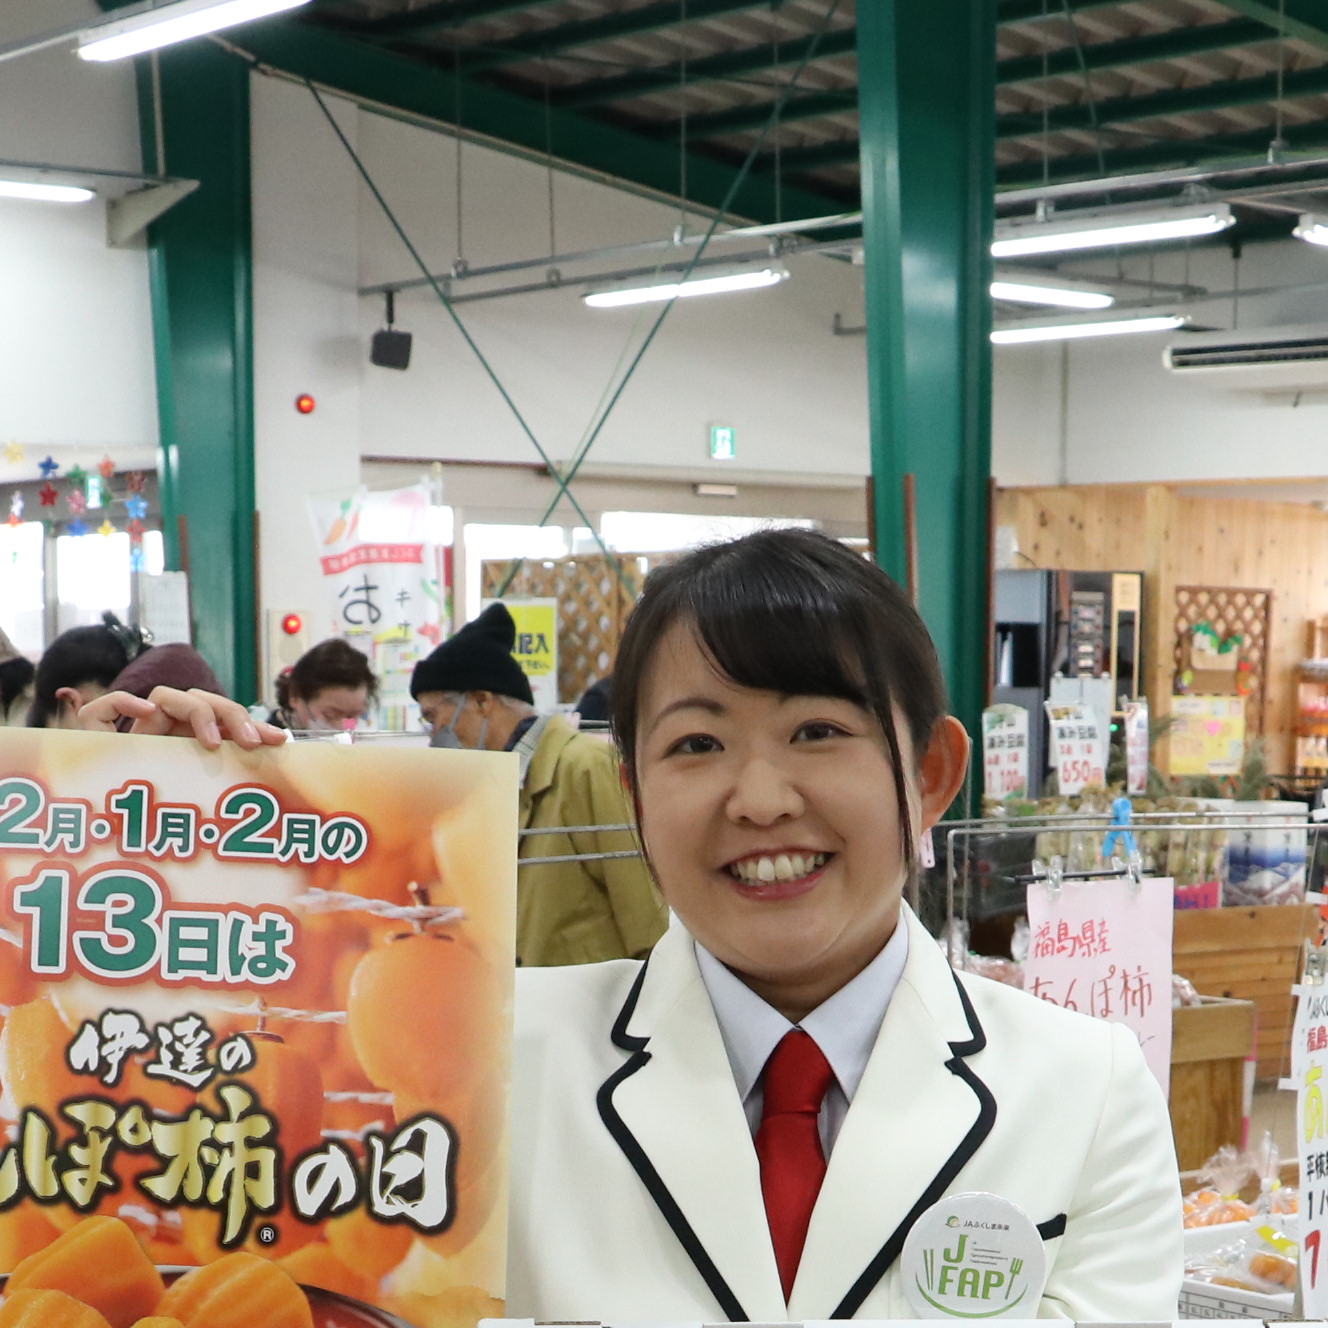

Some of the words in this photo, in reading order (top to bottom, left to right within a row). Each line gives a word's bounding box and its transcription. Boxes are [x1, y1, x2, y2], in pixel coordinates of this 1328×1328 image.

[13, 868, 297, 982] 13日は
[1032, 919, 1112, 960] 福島県産
[67, 1011, 256, 1085] 伊達の
[963, 1219, 1011, 1232] JAふくしま未来
[938, 1264, 1006, 1301] FAP
